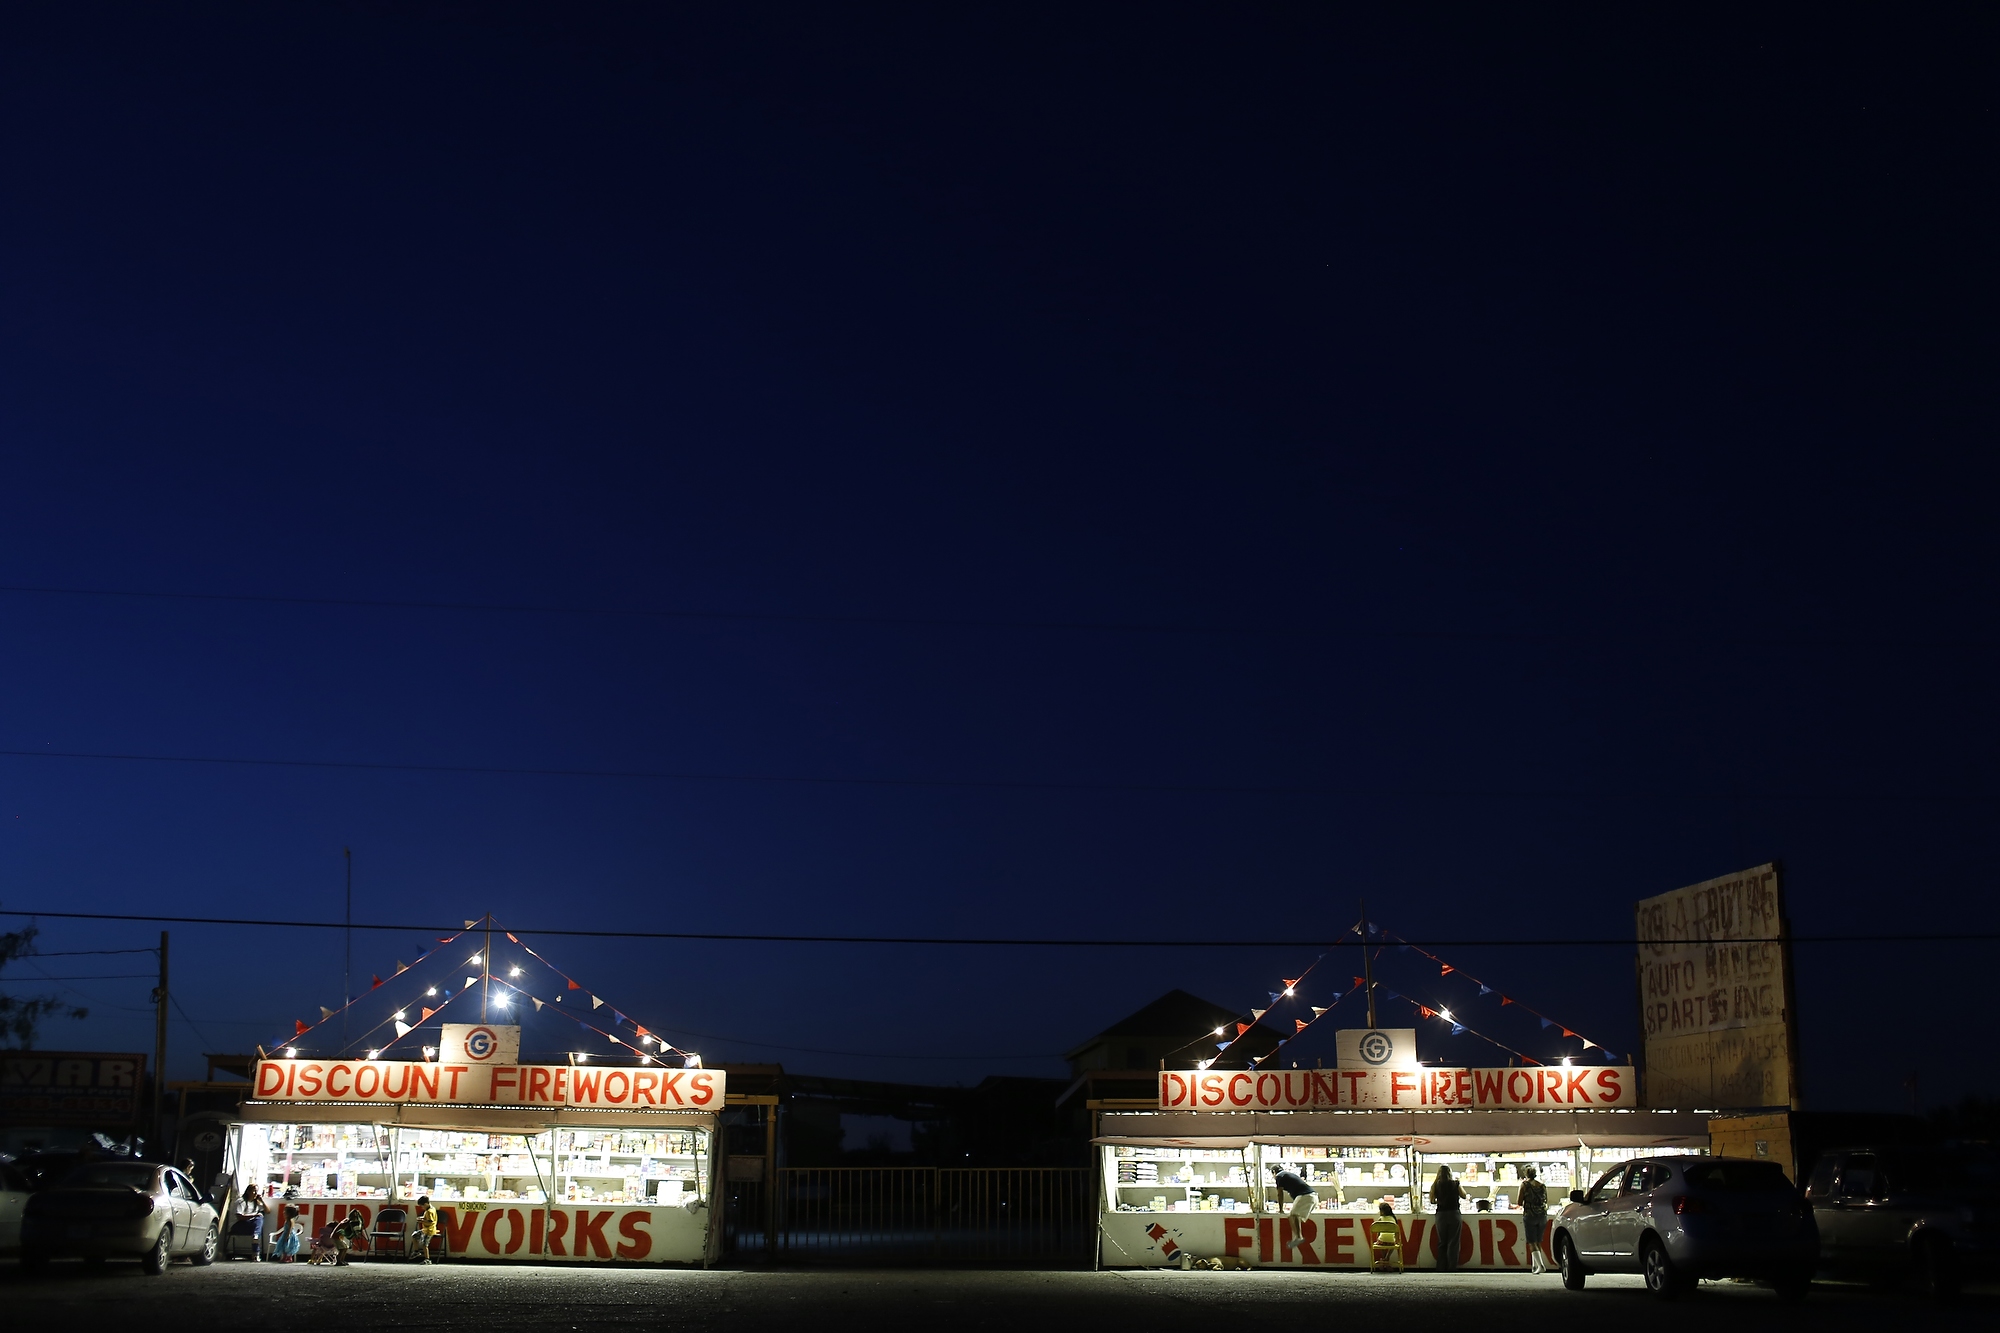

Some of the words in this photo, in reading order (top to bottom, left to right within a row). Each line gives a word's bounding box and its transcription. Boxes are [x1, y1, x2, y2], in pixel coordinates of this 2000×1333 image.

[470, 1034, 490, 1054] G
[1366, 1038, 1386, 1058] G
[258, 1063, 468, 1100] DISCOUNT
[490, 1067, 714, 1106] FIREWORKS
[1162, 1070, 1367, 1107] DISCOUNT
[1391, 1069, 1622, 1106] FIREWORKS
